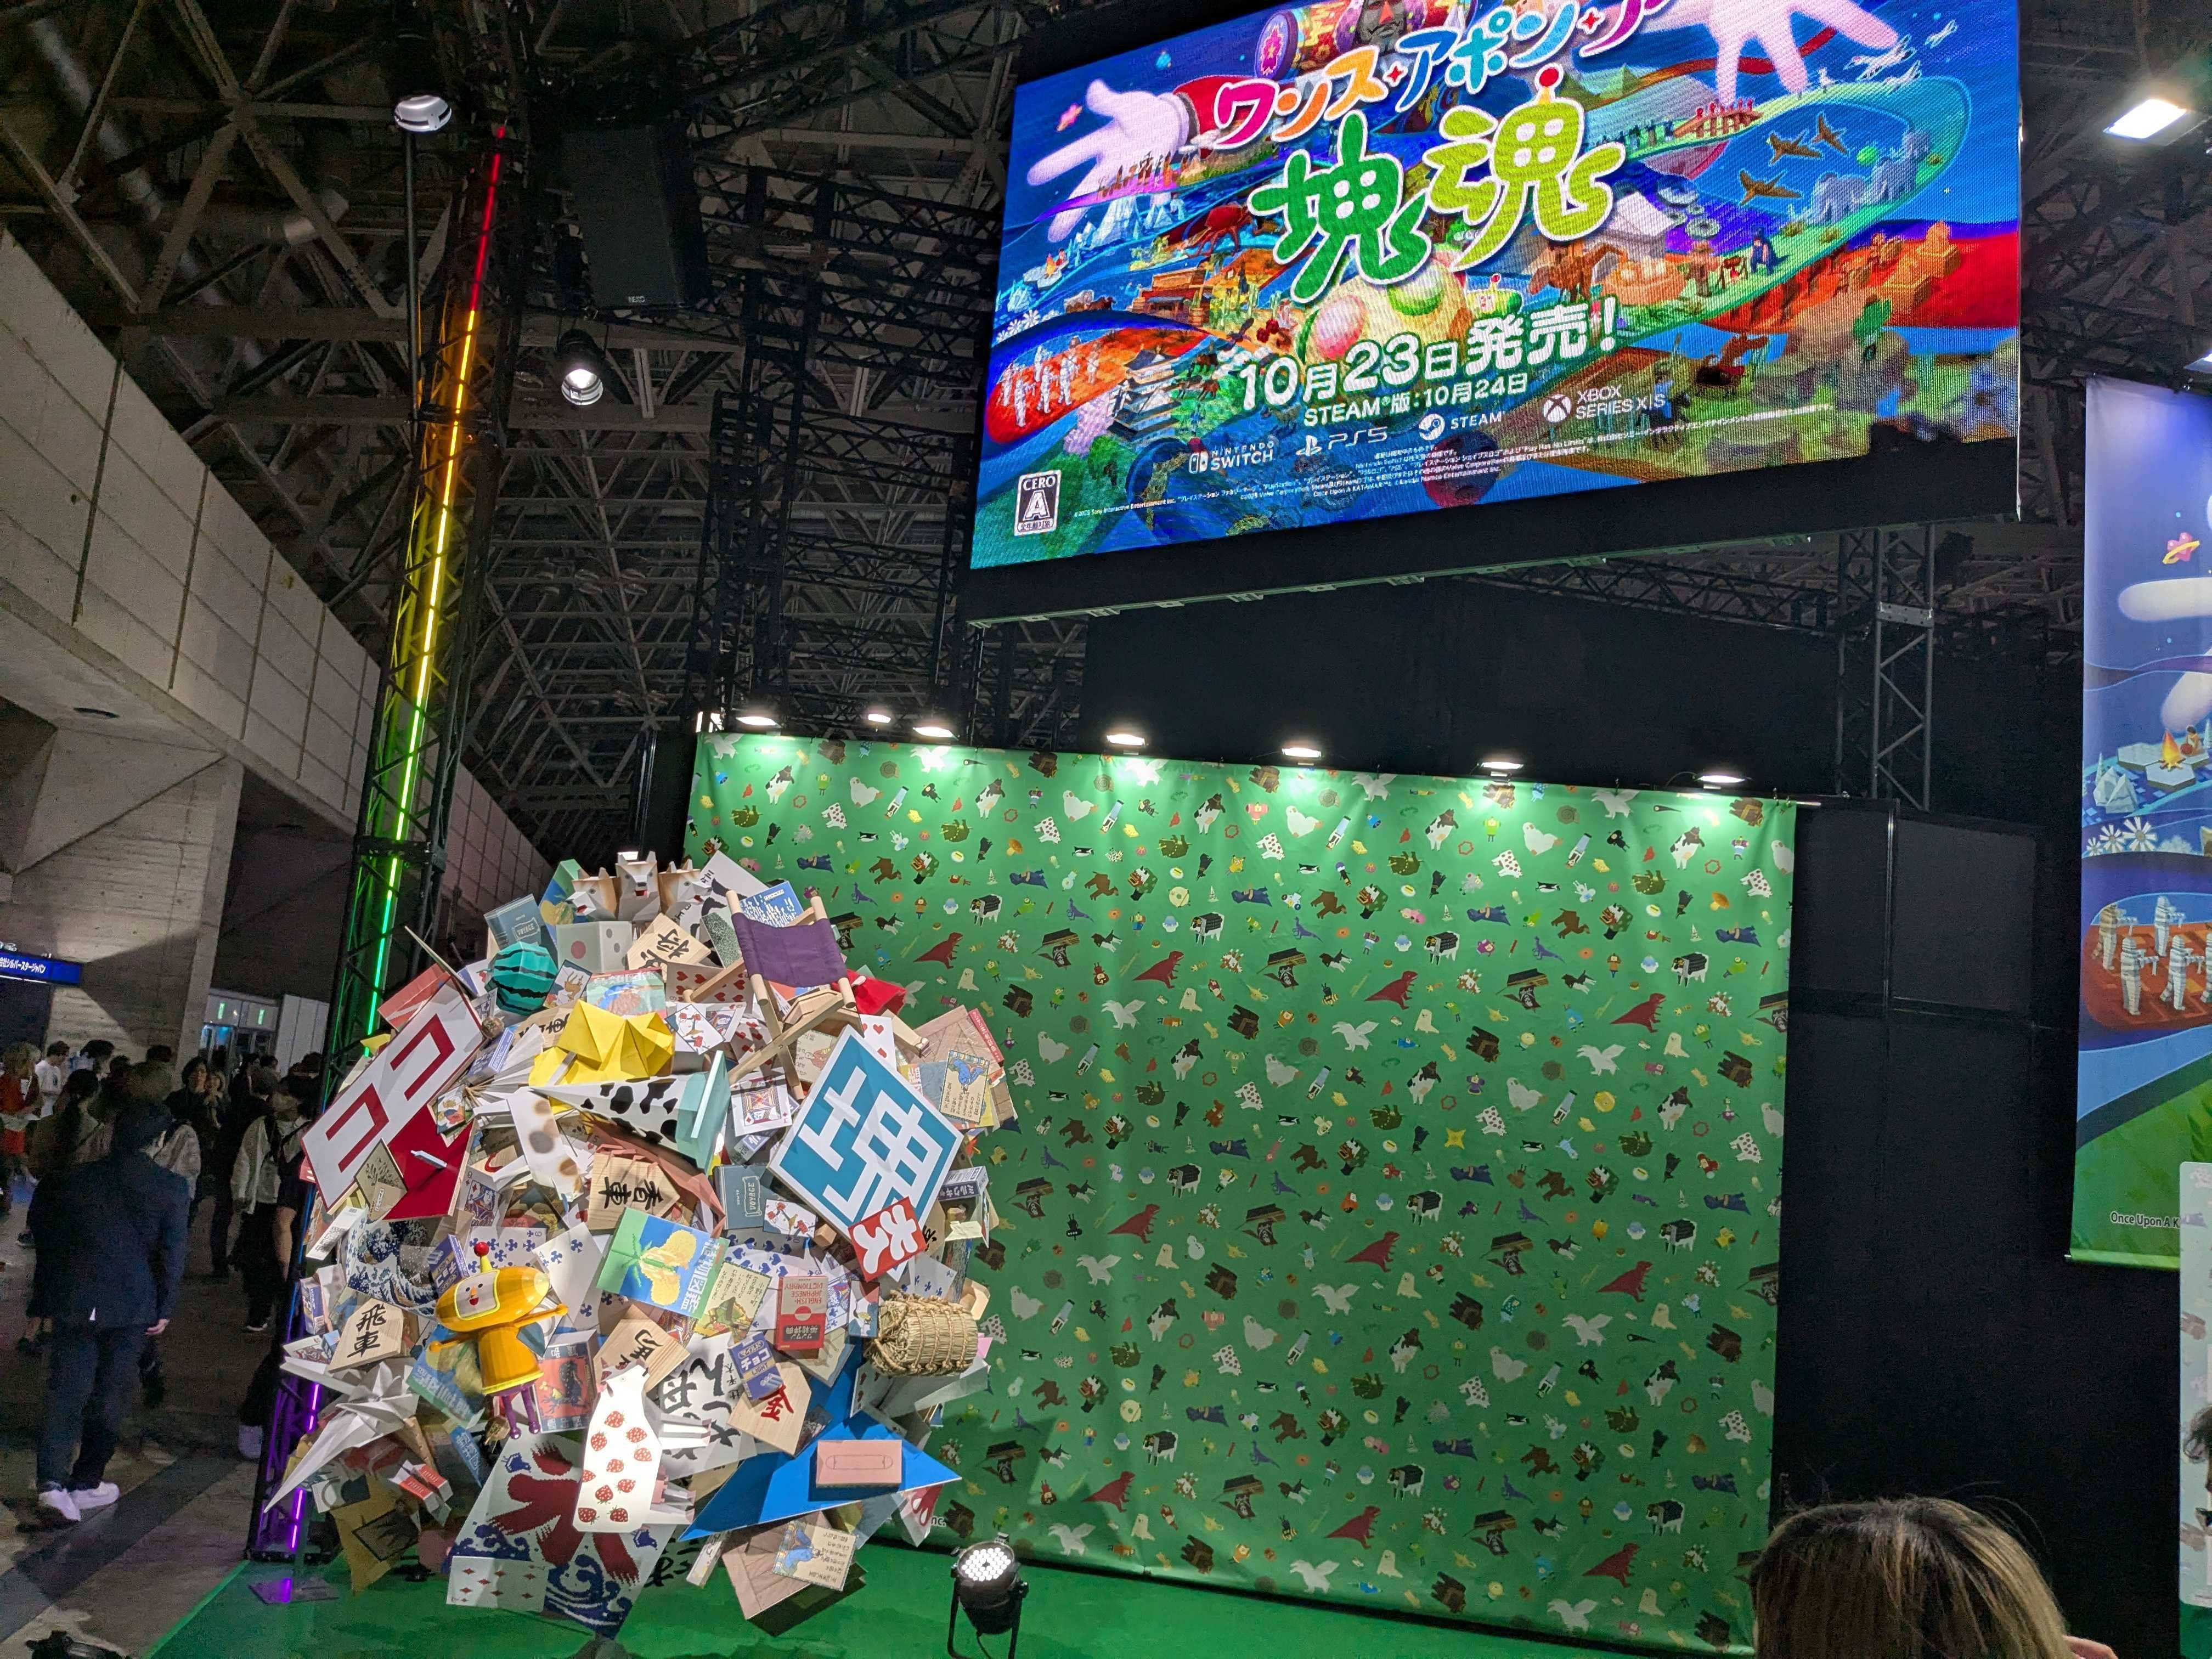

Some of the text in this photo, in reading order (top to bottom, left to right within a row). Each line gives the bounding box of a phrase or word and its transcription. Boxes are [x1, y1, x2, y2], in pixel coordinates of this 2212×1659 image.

[1246, 65, 1627, 303] 塊魂
[1576, 384, 1622, 404] XBOX
[1575, 396, 1633, 419] SERIES
[1450, 410, 1505, 429] STEAM
[1328, 426, 1388, 449] PS5
[1211, 441, 1274, 457] NINTENDO
[1210, 451, 1274, 472] SWITCH
[1023, 476, 1056, 491] CERO
[1023, 489, 1050, 521] A
[939, 1185, 975, 1197] ミルクキャ
[2111, 1211, 2135, 1224] Once
[2136, 1214, 2162, 1228] Upon
[2162, 1217, 2170, 1227] A
[348, 1302, 387, 1358] 飛車
[741, 1351, 770, 1371] チョコ
